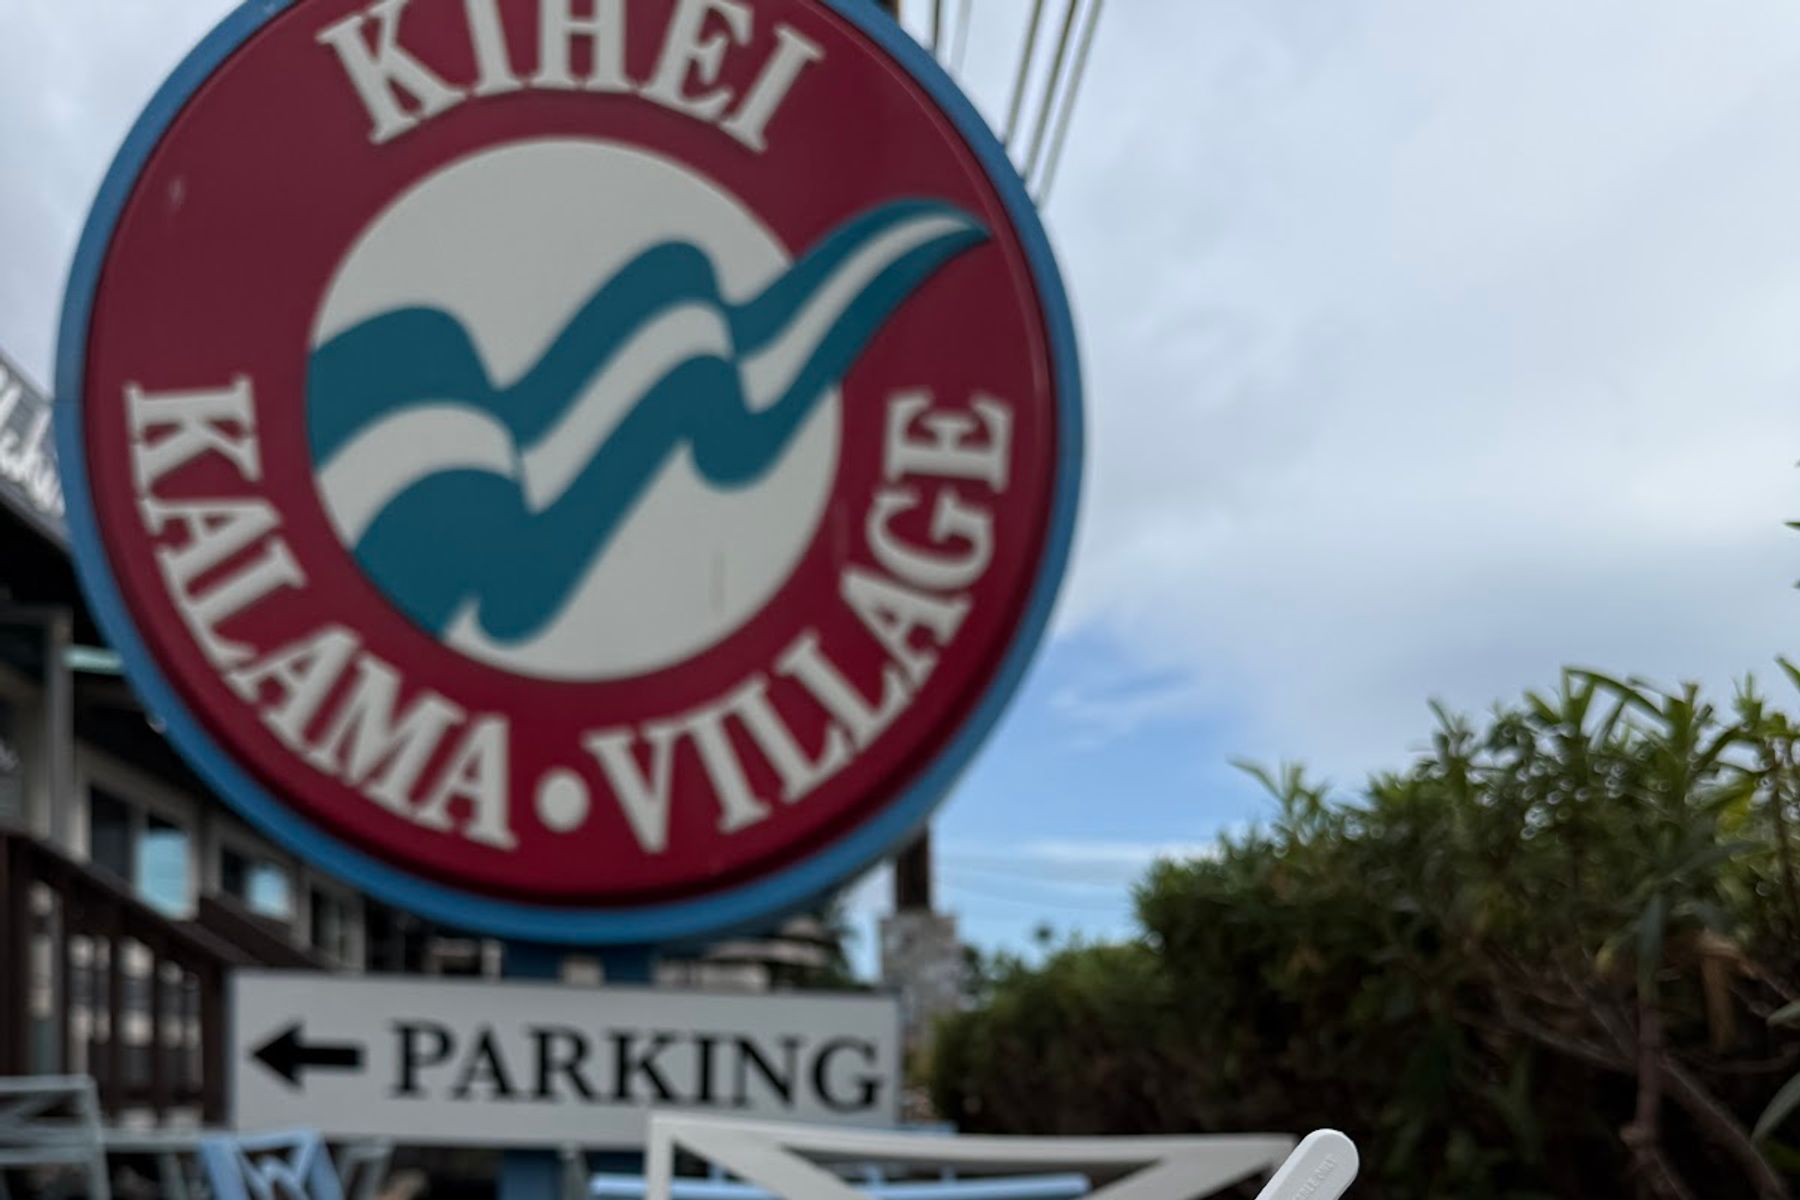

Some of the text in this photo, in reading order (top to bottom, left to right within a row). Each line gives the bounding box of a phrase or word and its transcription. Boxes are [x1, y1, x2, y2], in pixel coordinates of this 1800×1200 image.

[316, 0, 824, 152] KIHEI
[123, 376, 1016, 852] KALAMA VILLAGE
[390, 1017, 884, 1113] PARKING
